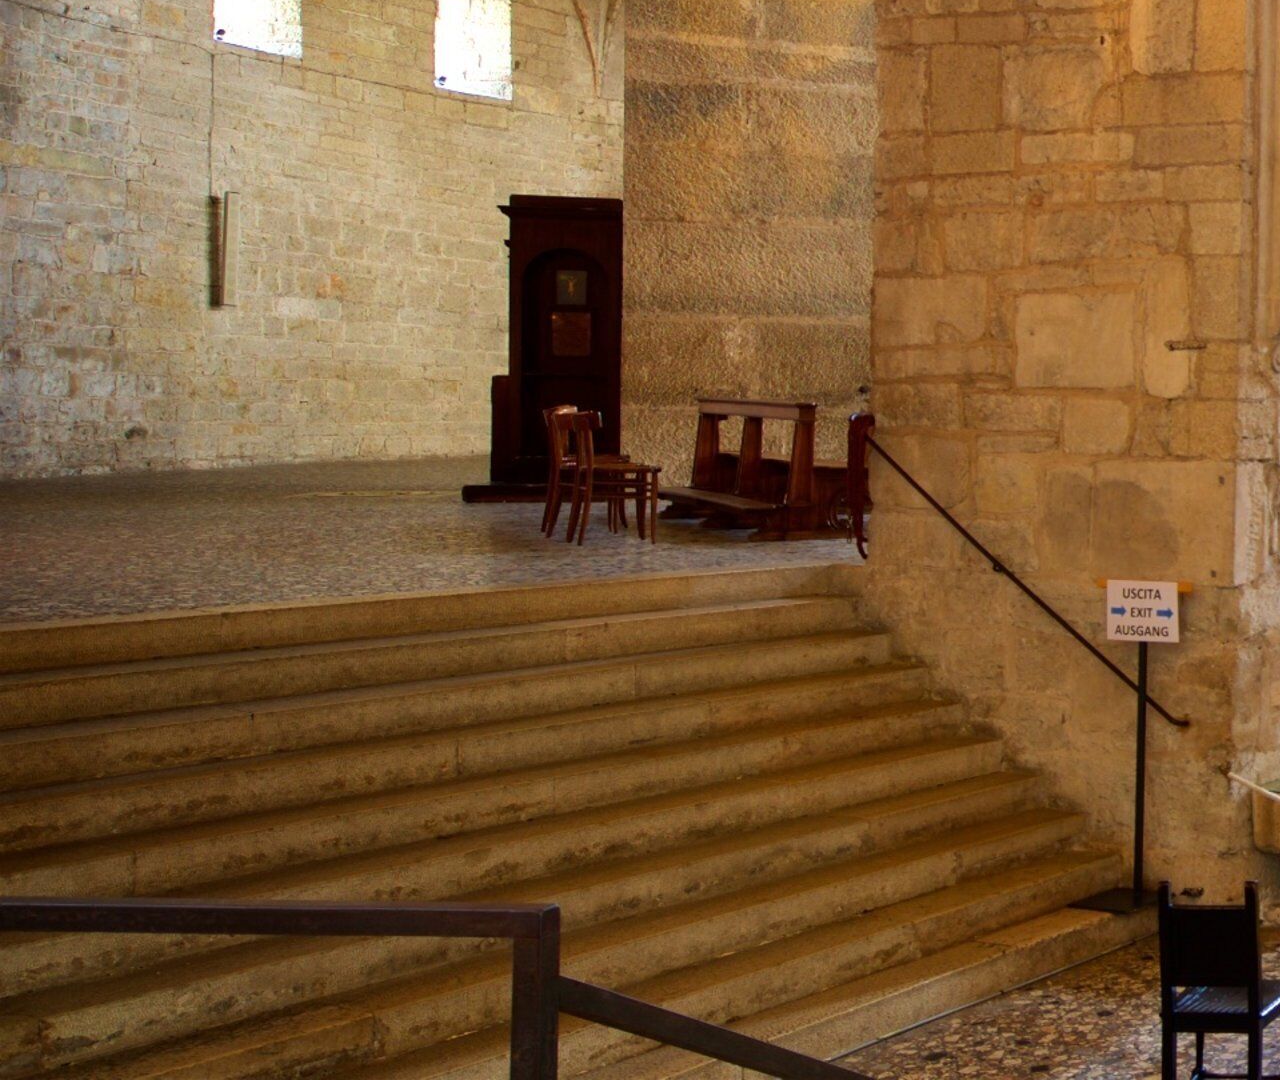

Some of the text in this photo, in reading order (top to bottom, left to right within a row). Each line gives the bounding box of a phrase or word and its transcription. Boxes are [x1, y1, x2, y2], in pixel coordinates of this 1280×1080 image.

[1122, 587, 1162, 600] USCITA
[1130, 607, 1153, 618] EXIT
[1114, 624, 1169, 637] AUSGANG
